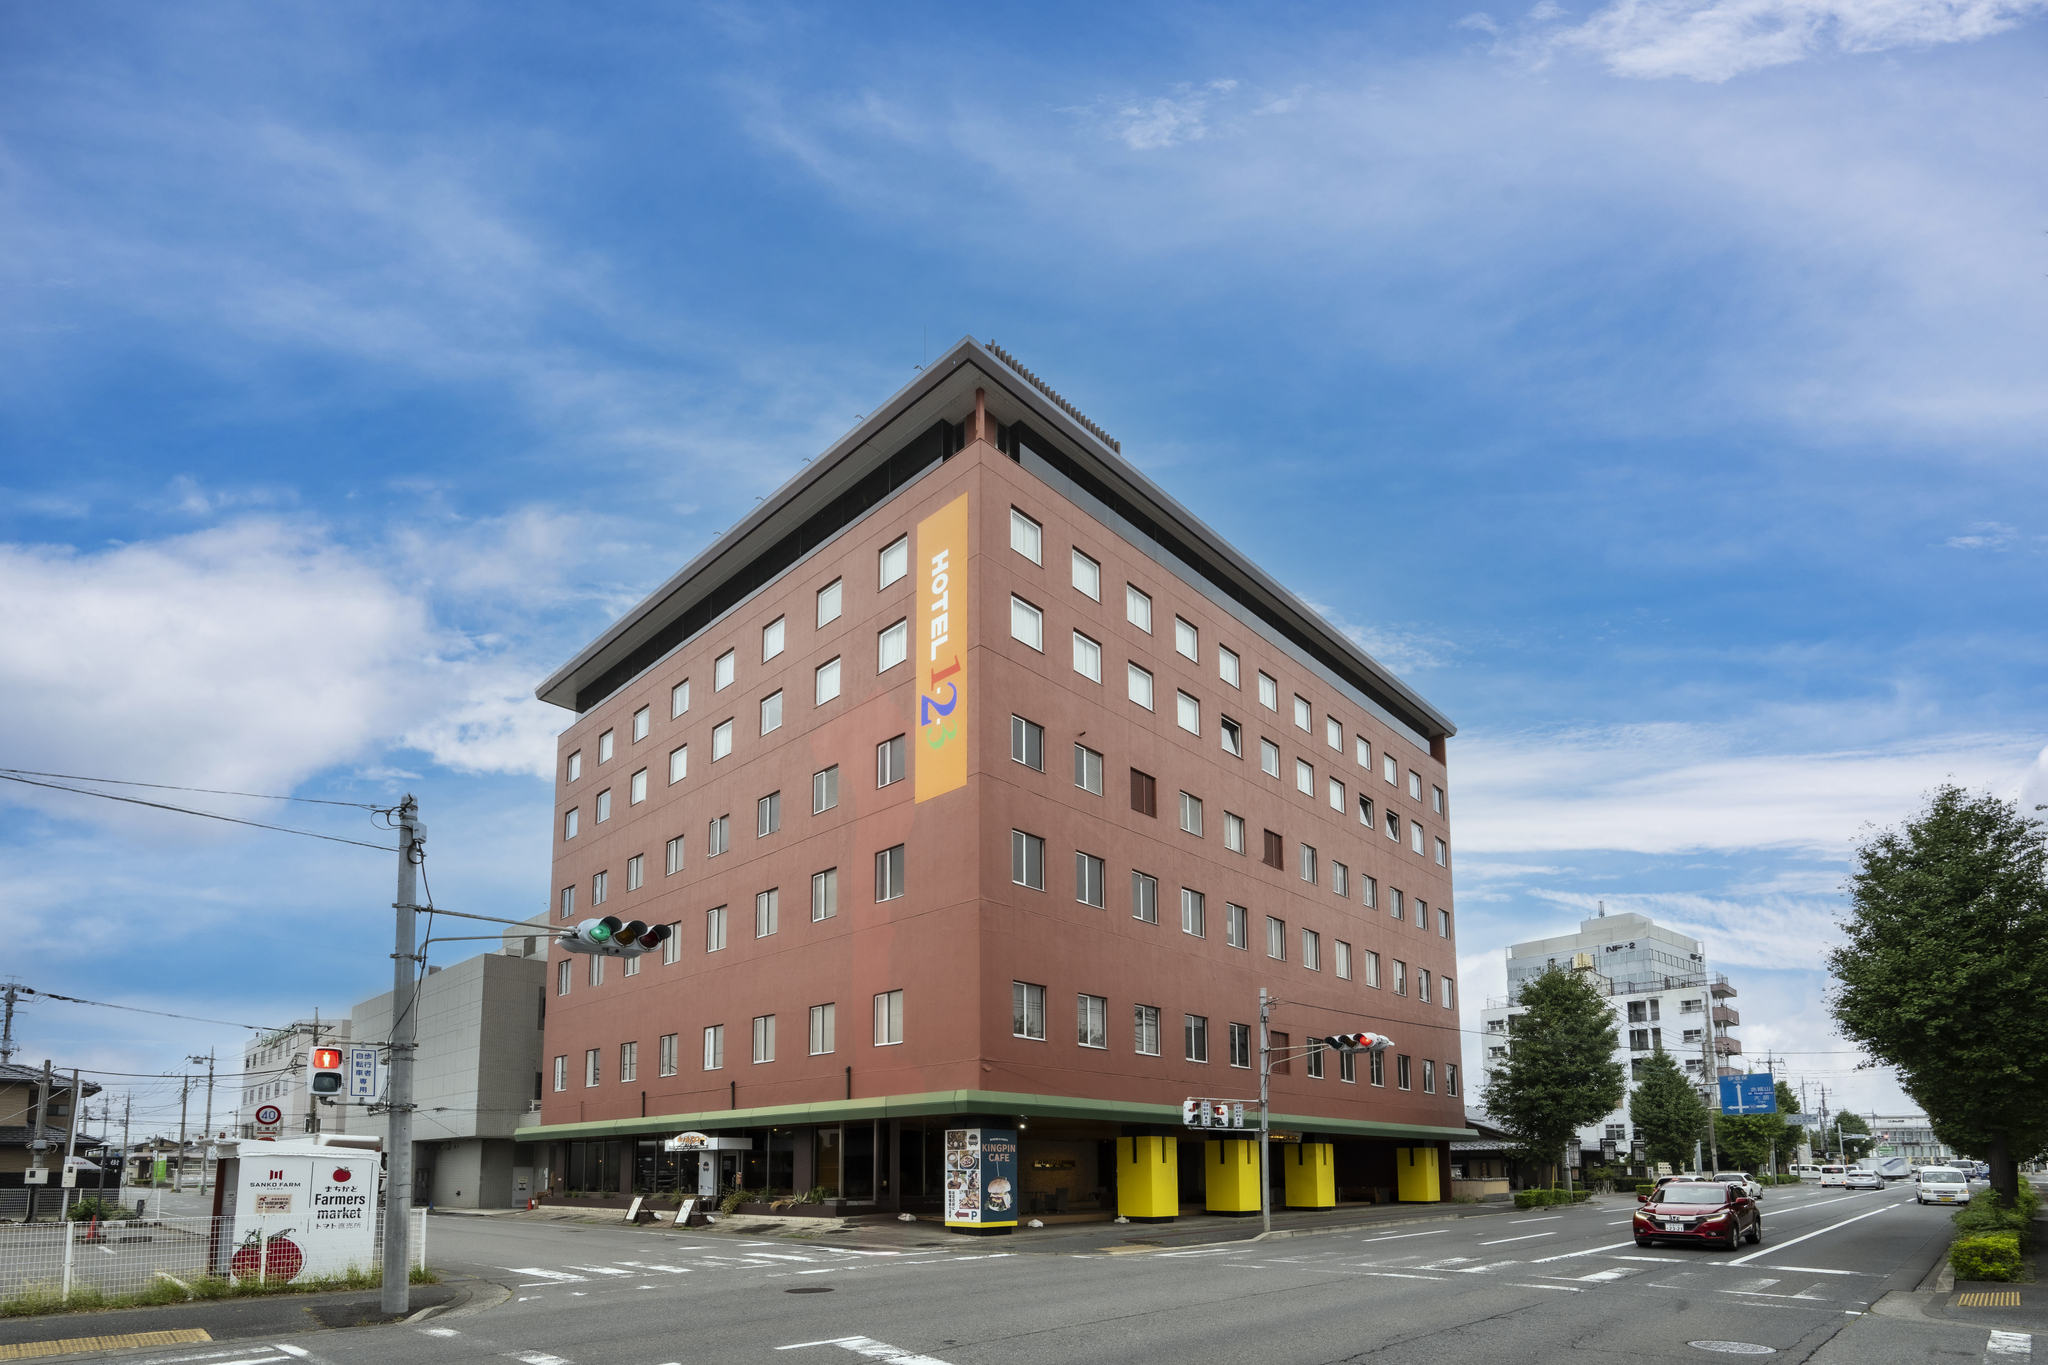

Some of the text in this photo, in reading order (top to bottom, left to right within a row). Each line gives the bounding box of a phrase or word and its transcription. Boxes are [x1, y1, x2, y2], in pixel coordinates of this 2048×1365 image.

[931, 548, 949, 661] HOTEL
[355, 1053, 364, 1076] 自転車
[364, 1053, 372, 1077] 歩行者
[359, 1078, 367, 1093] 専用
[261, 1110, 276, 1120] 40
[982, 1144, 1016, 1152] KINGPIN
[988, 1153, 1010, 1162] CAFE
[315, 1193, 366, 1206] Farmers
[317, 1207, 362, 1219] market
[971, 1211, 978, 1220] P
